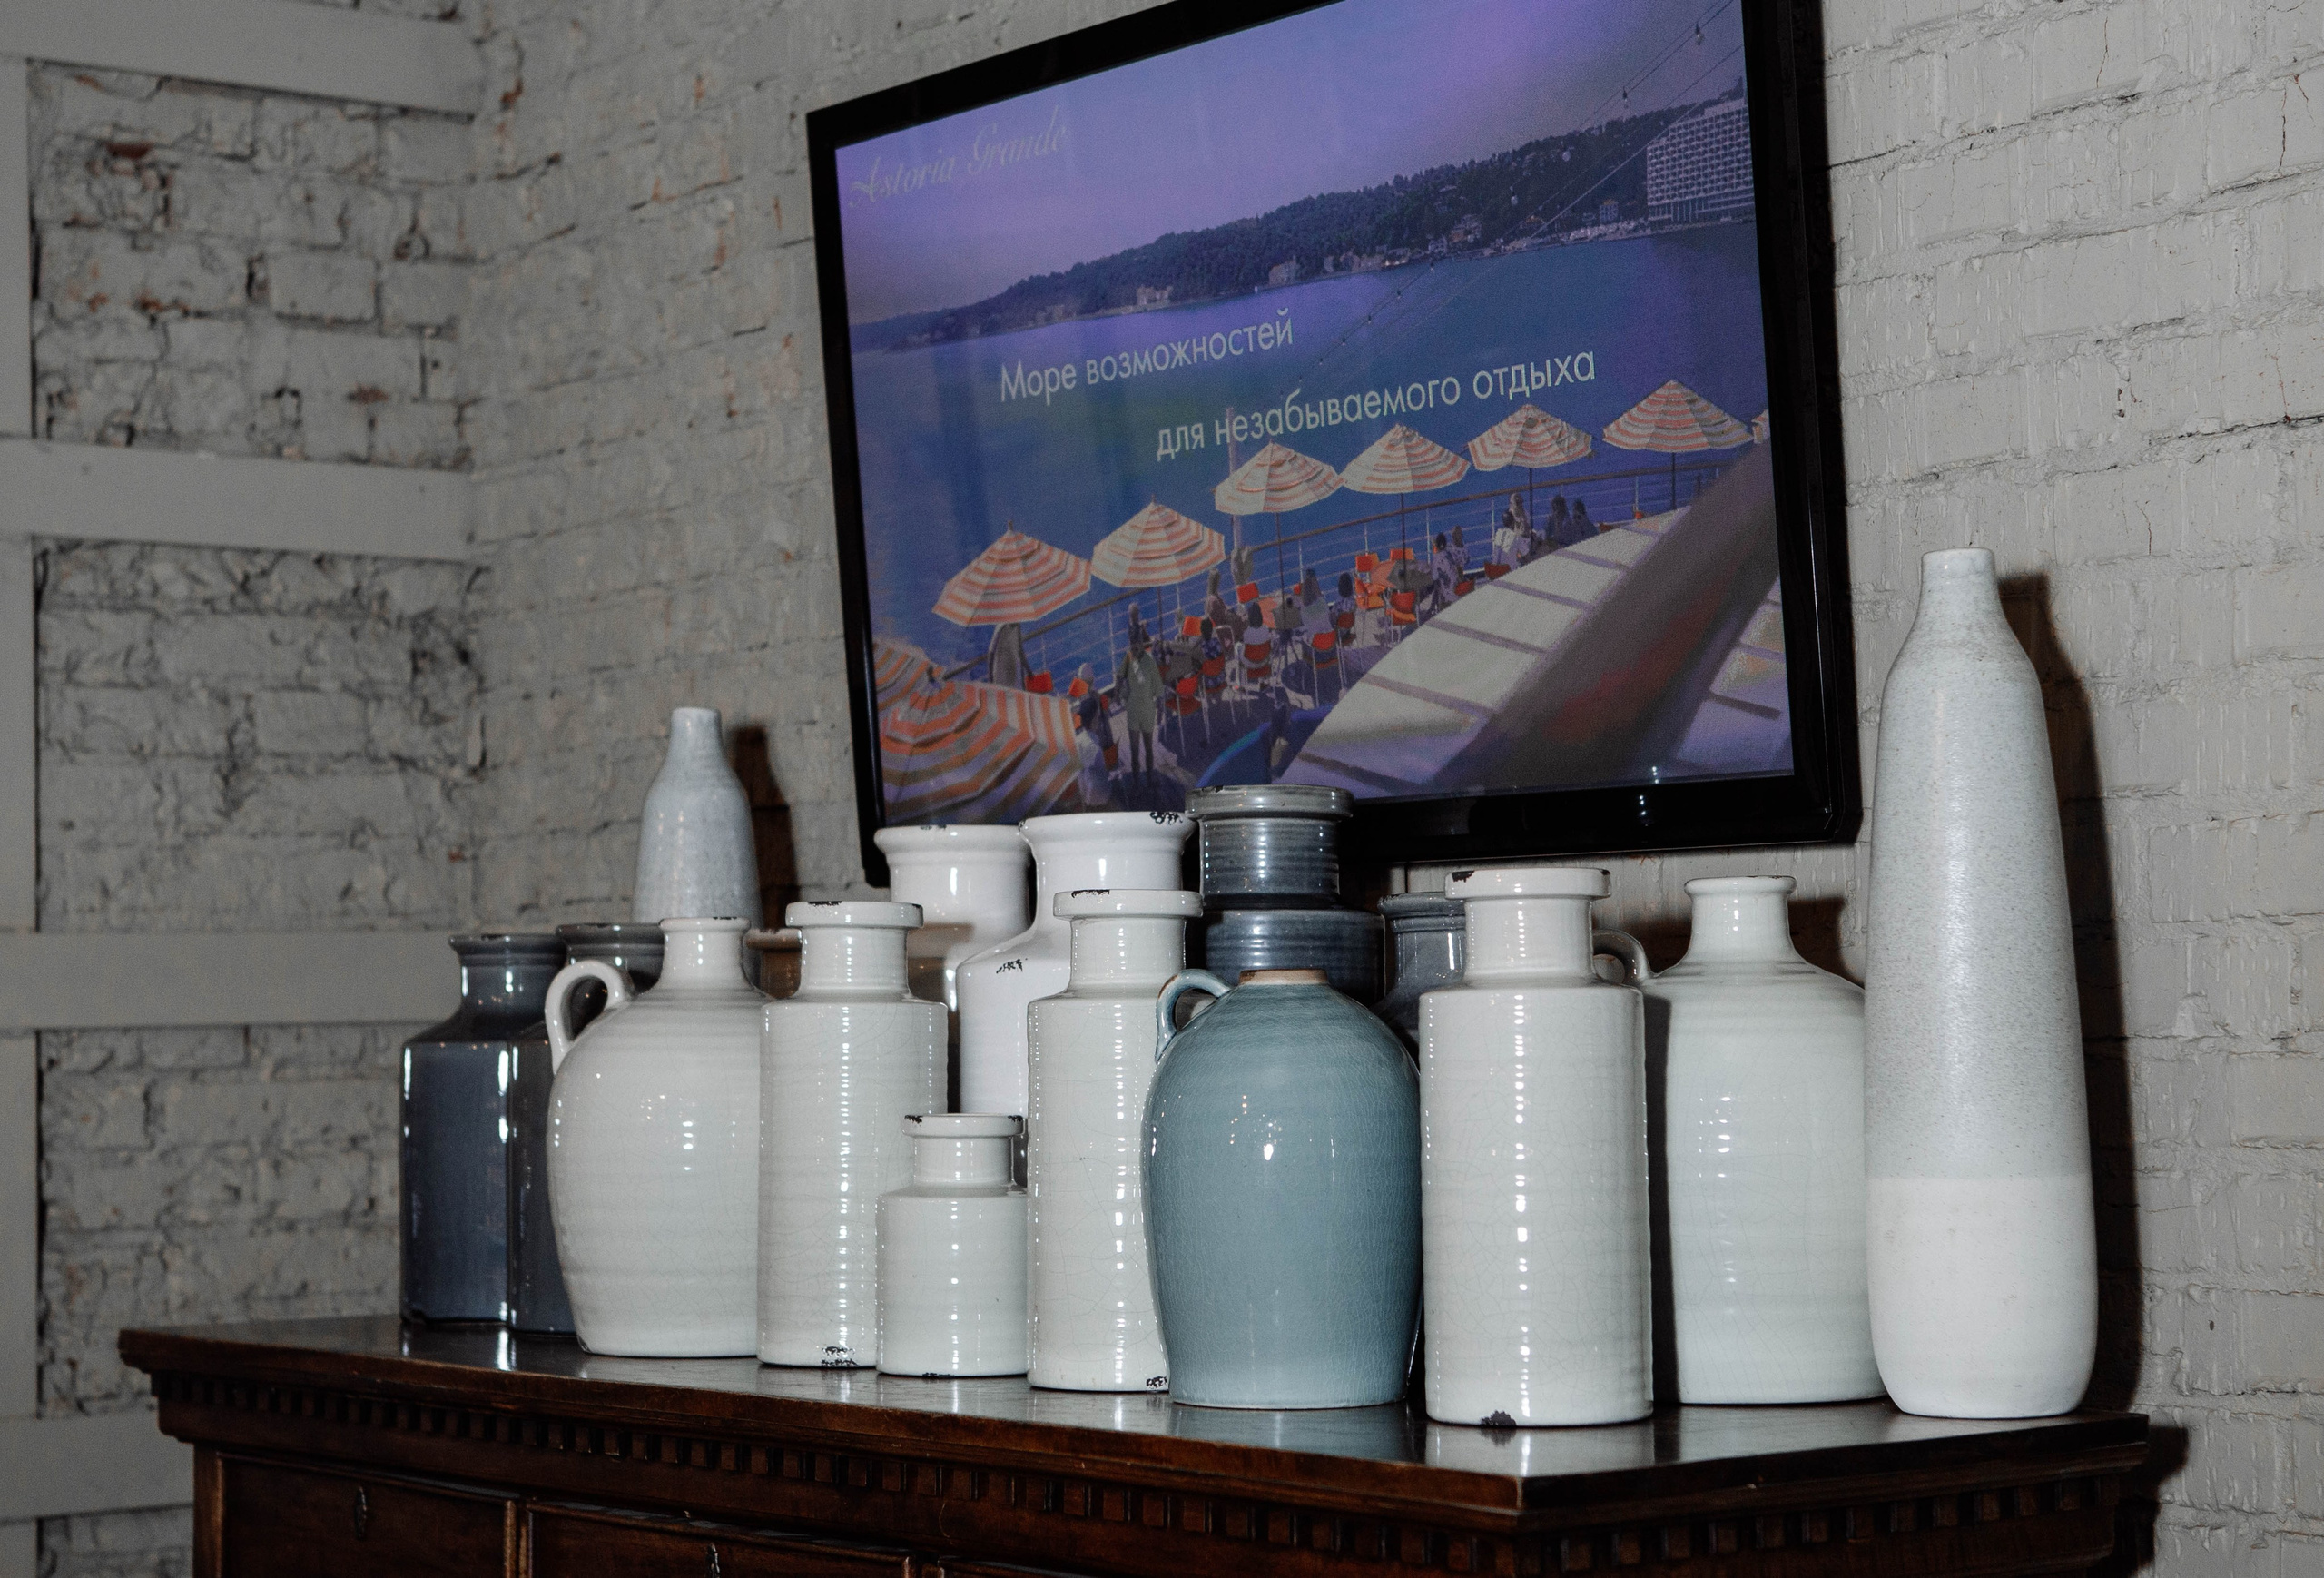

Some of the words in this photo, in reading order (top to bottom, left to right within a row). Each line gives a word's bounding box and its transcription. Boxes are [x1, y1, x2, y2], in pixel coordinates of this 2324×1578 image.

[849, 148, 956, 208] Astoria
[1000, 360, 1077, 406] Море
[1087, 307, 1294, 385] возможностей
[1157, 422, 1205, 461] для
[1216, 376, 1461, 446] незабываемого
[1472, 350, 1596, 400] отдыха
